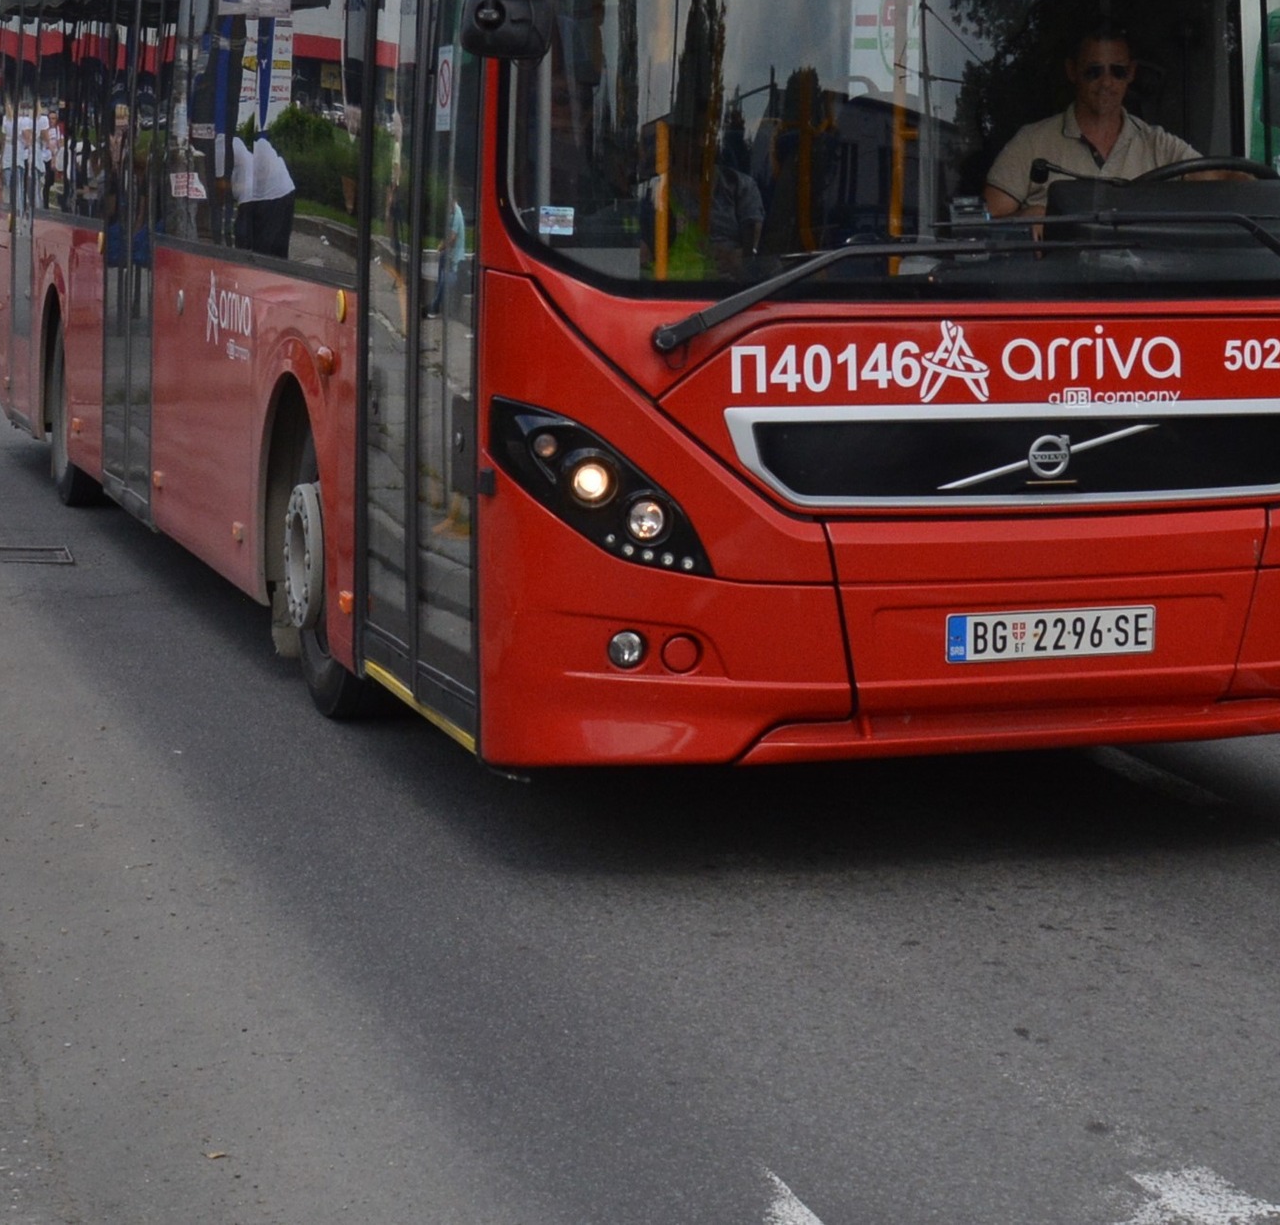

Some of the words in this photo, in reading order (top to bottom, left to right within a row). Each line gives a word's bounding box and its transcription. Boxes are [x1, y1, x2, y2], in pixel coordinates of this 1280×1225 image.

[220, 282, 252, 337] arriva
[1001, 324, 1181, 381] arriva
[1048, 391, 1060, 405] a
[1065, 389, 1090, 406] DB
[1094, 389, 1181, 408] company
[1032, 453, 1068, 461] VOLVO
[973, 621, 1008, 654] BG
